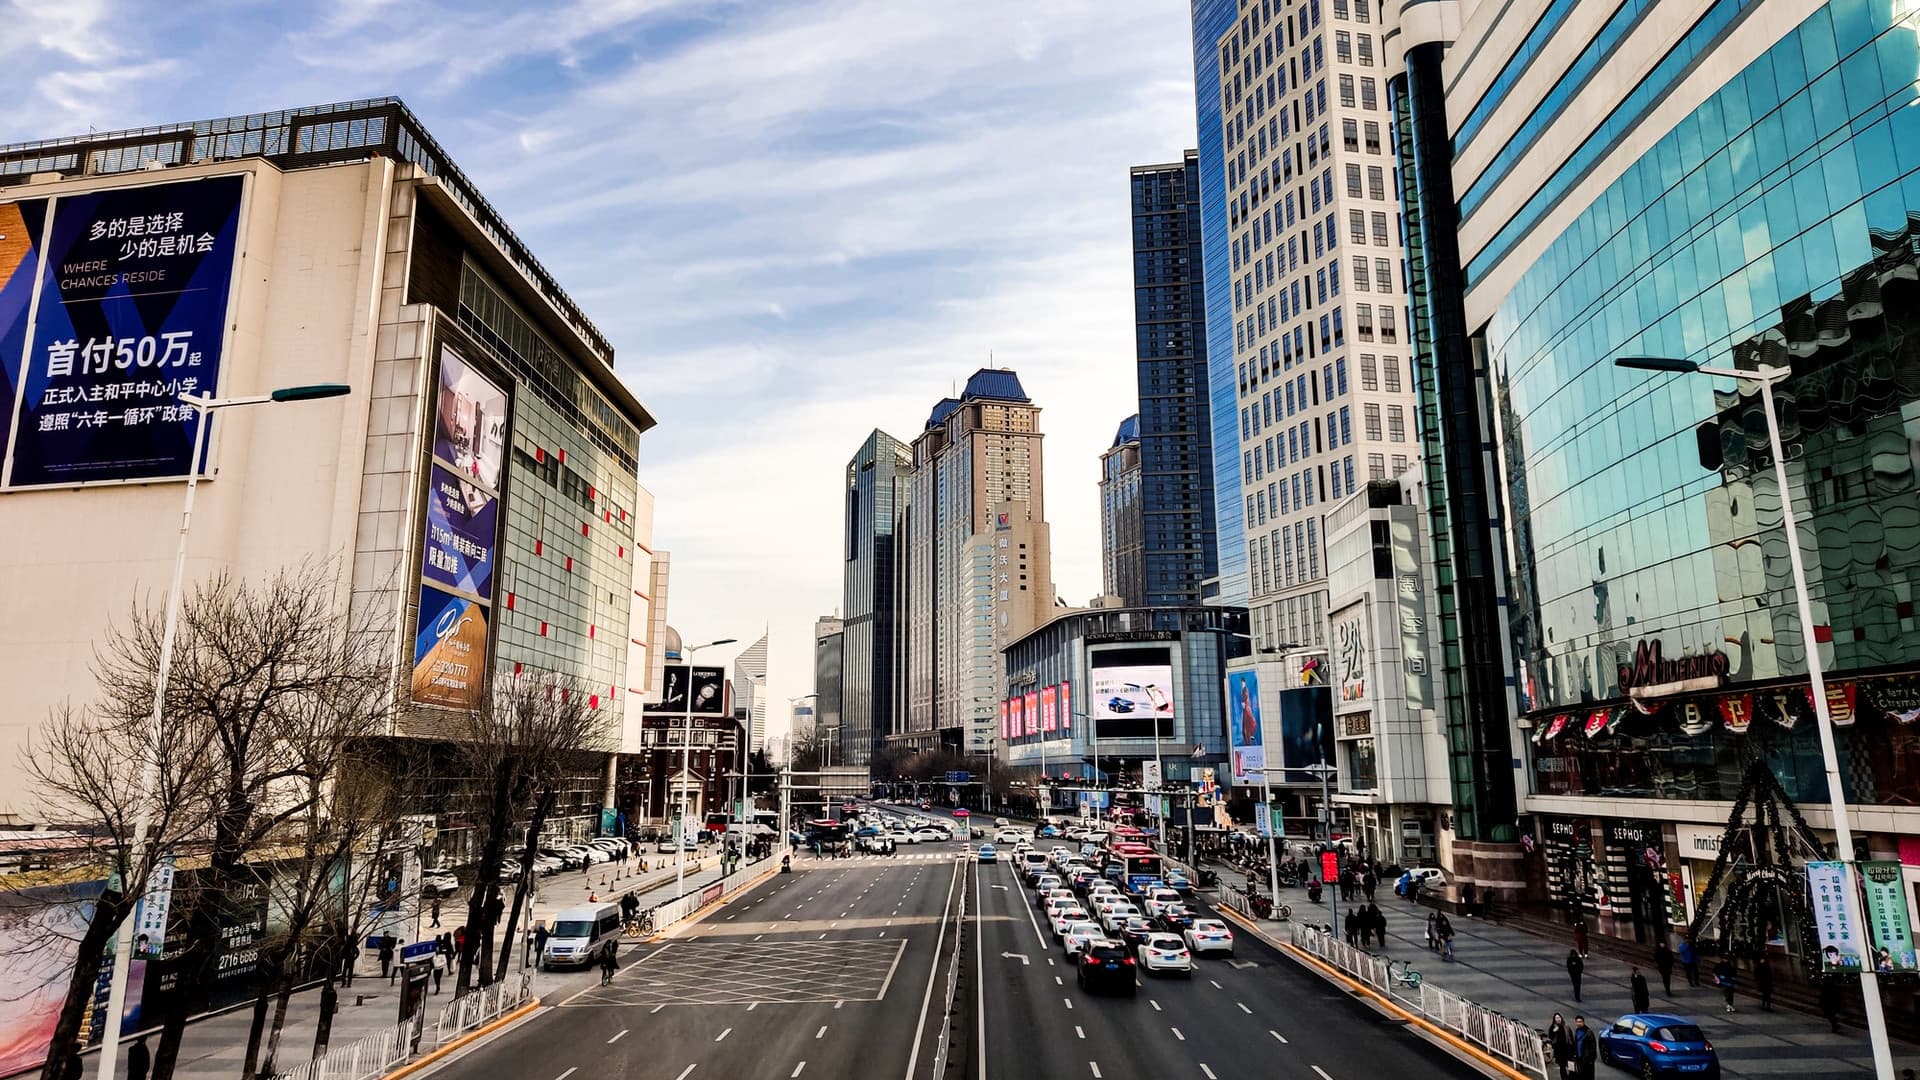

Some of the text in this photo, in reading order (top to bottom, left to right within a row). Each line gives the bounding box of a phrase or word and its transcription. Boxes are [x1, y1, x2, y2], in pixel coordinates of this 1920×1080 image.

[89, 212, 184, 241] 多的是选择
[118, 232, 215, 261] 少的是机会
[63, 260, 107, 273] WHERE
[60, 269, 166, 290] CHANCES RESIDE
[46, 330, 202, 378] 首付50万起
[42, 377, 198, 406] 正式入主和平中心小学
[1552, 823, 1574, 836] SEPHO
[1693, 834, 1723, 851] innisf
[218, 952, 238, 970] 2716
